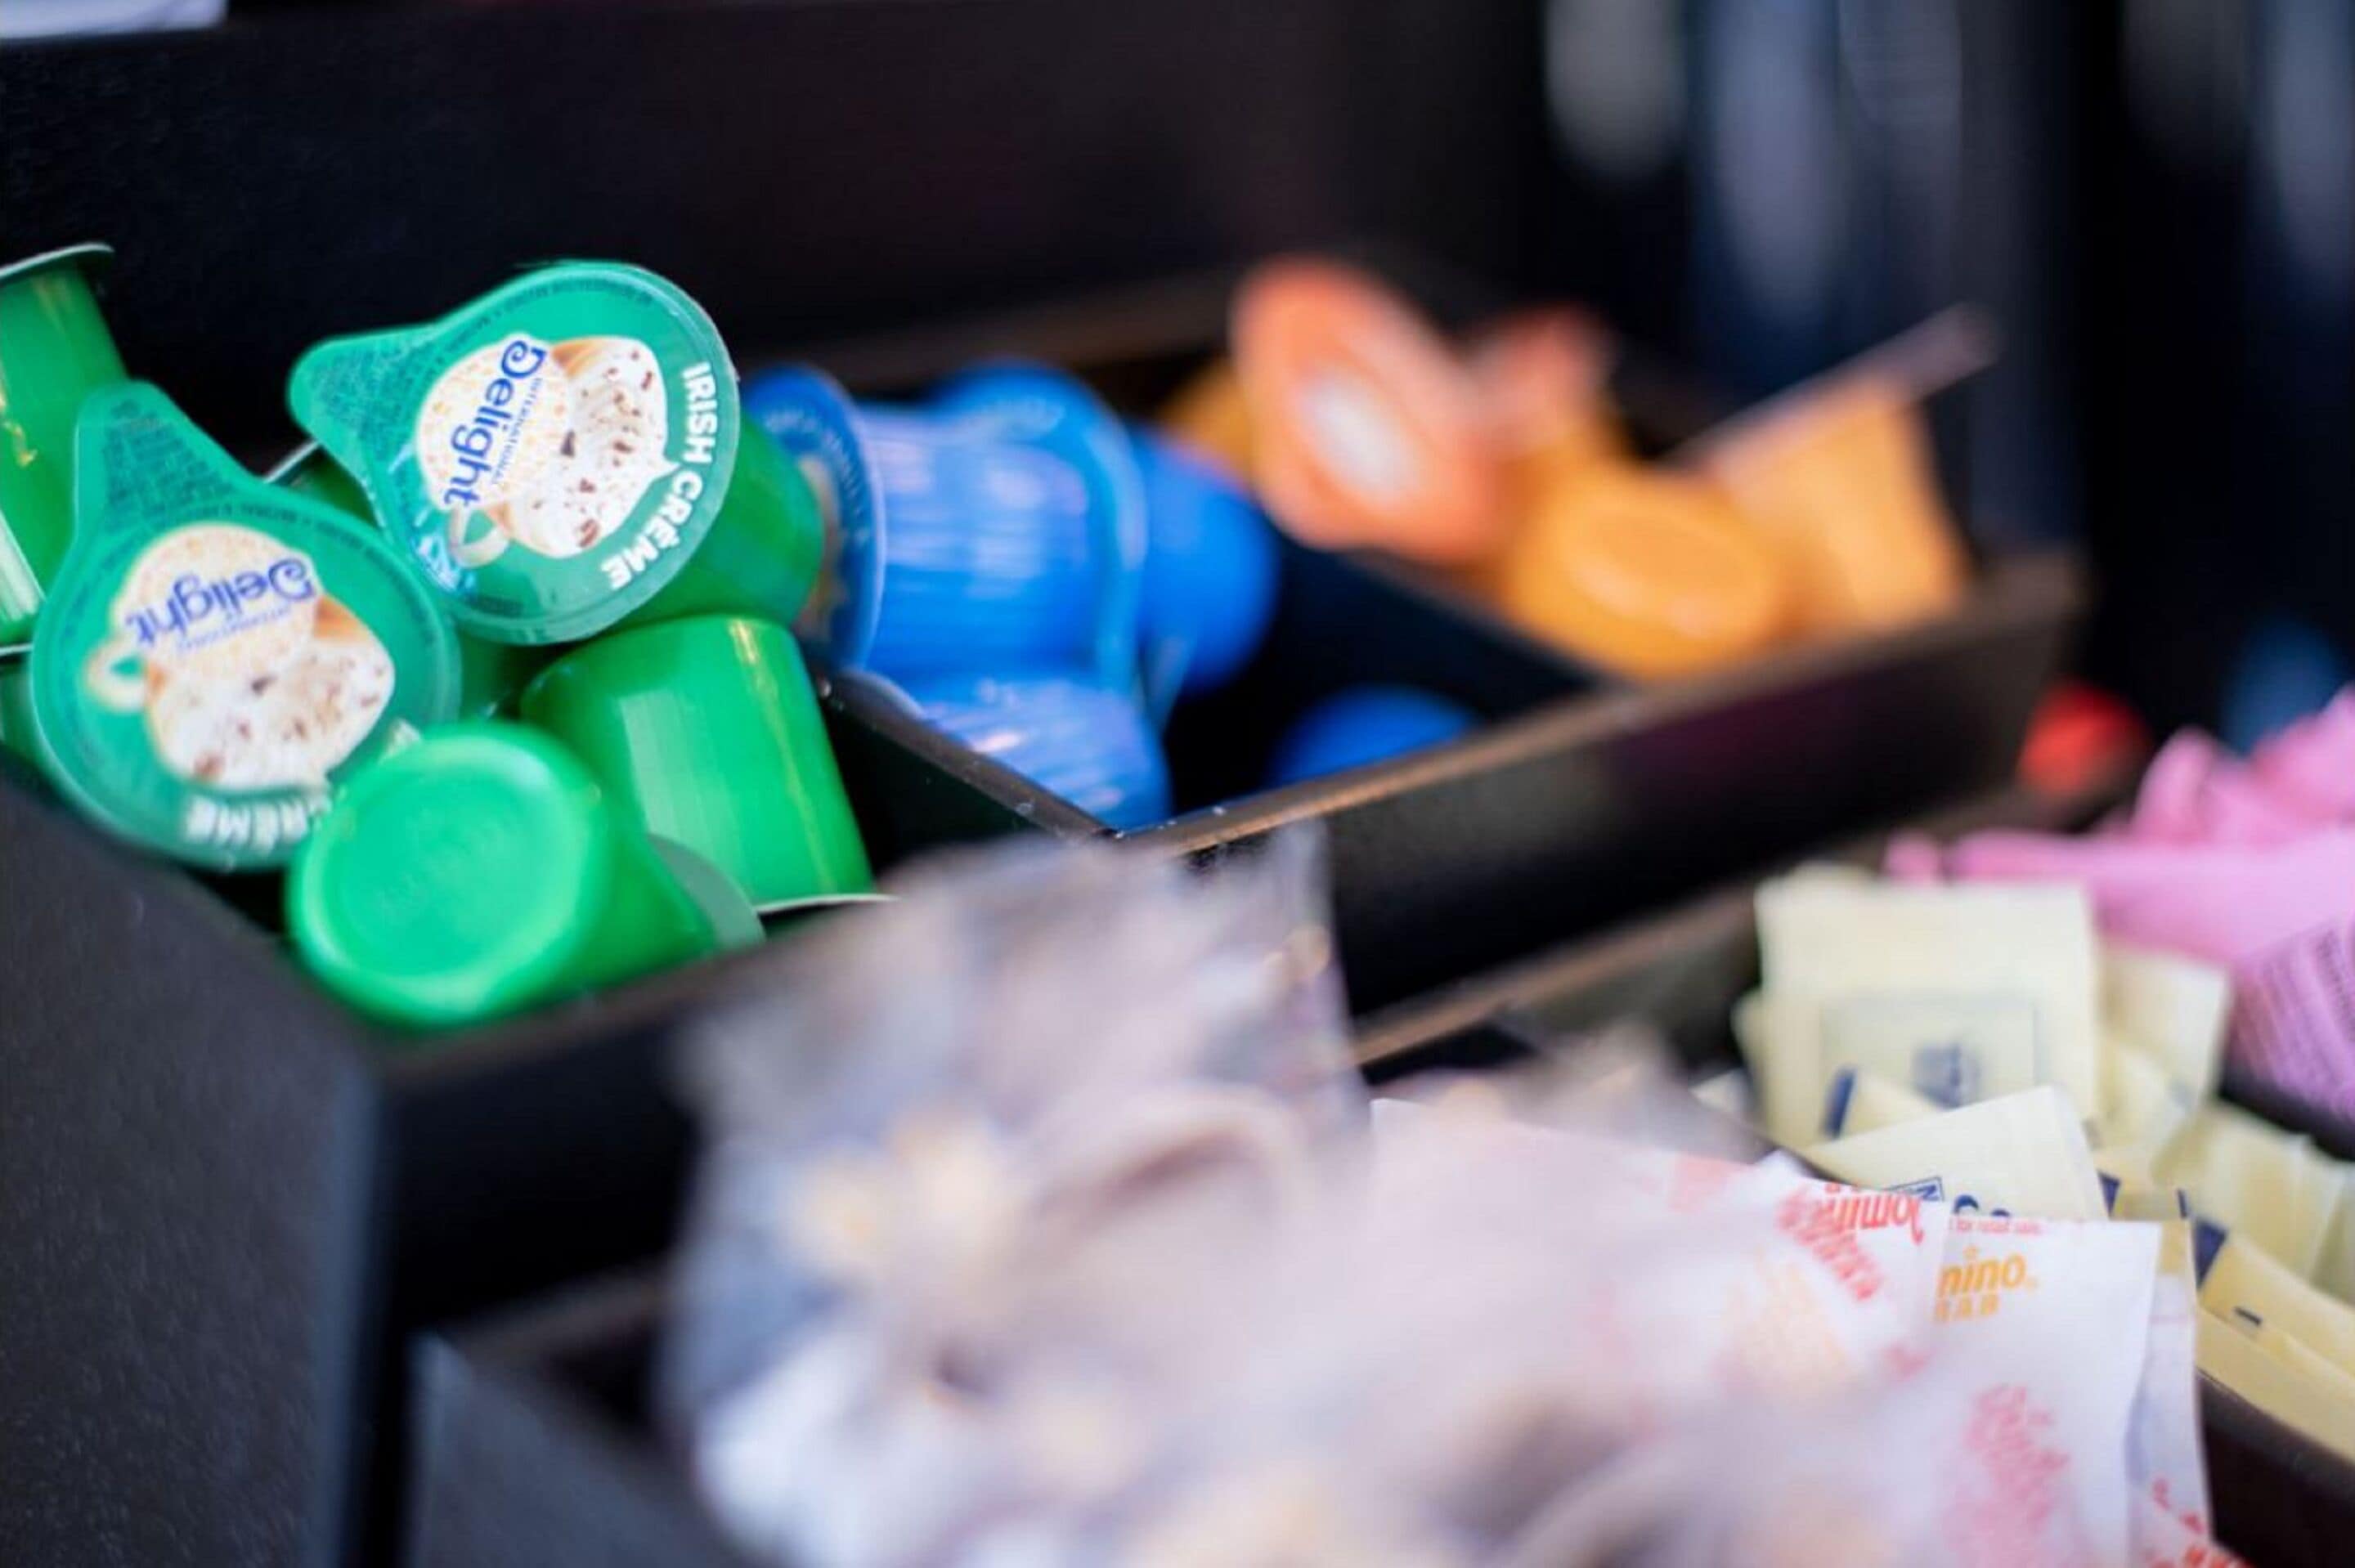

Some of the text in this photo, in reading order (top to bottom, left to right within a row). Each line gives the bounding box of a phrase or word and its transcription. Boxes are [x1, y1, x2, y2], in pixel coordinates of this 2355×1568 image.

[443, 340, 547, 507] Delight
[682, 361, 718, 464] IRISH
[126, 557, 317, 645] Delight
